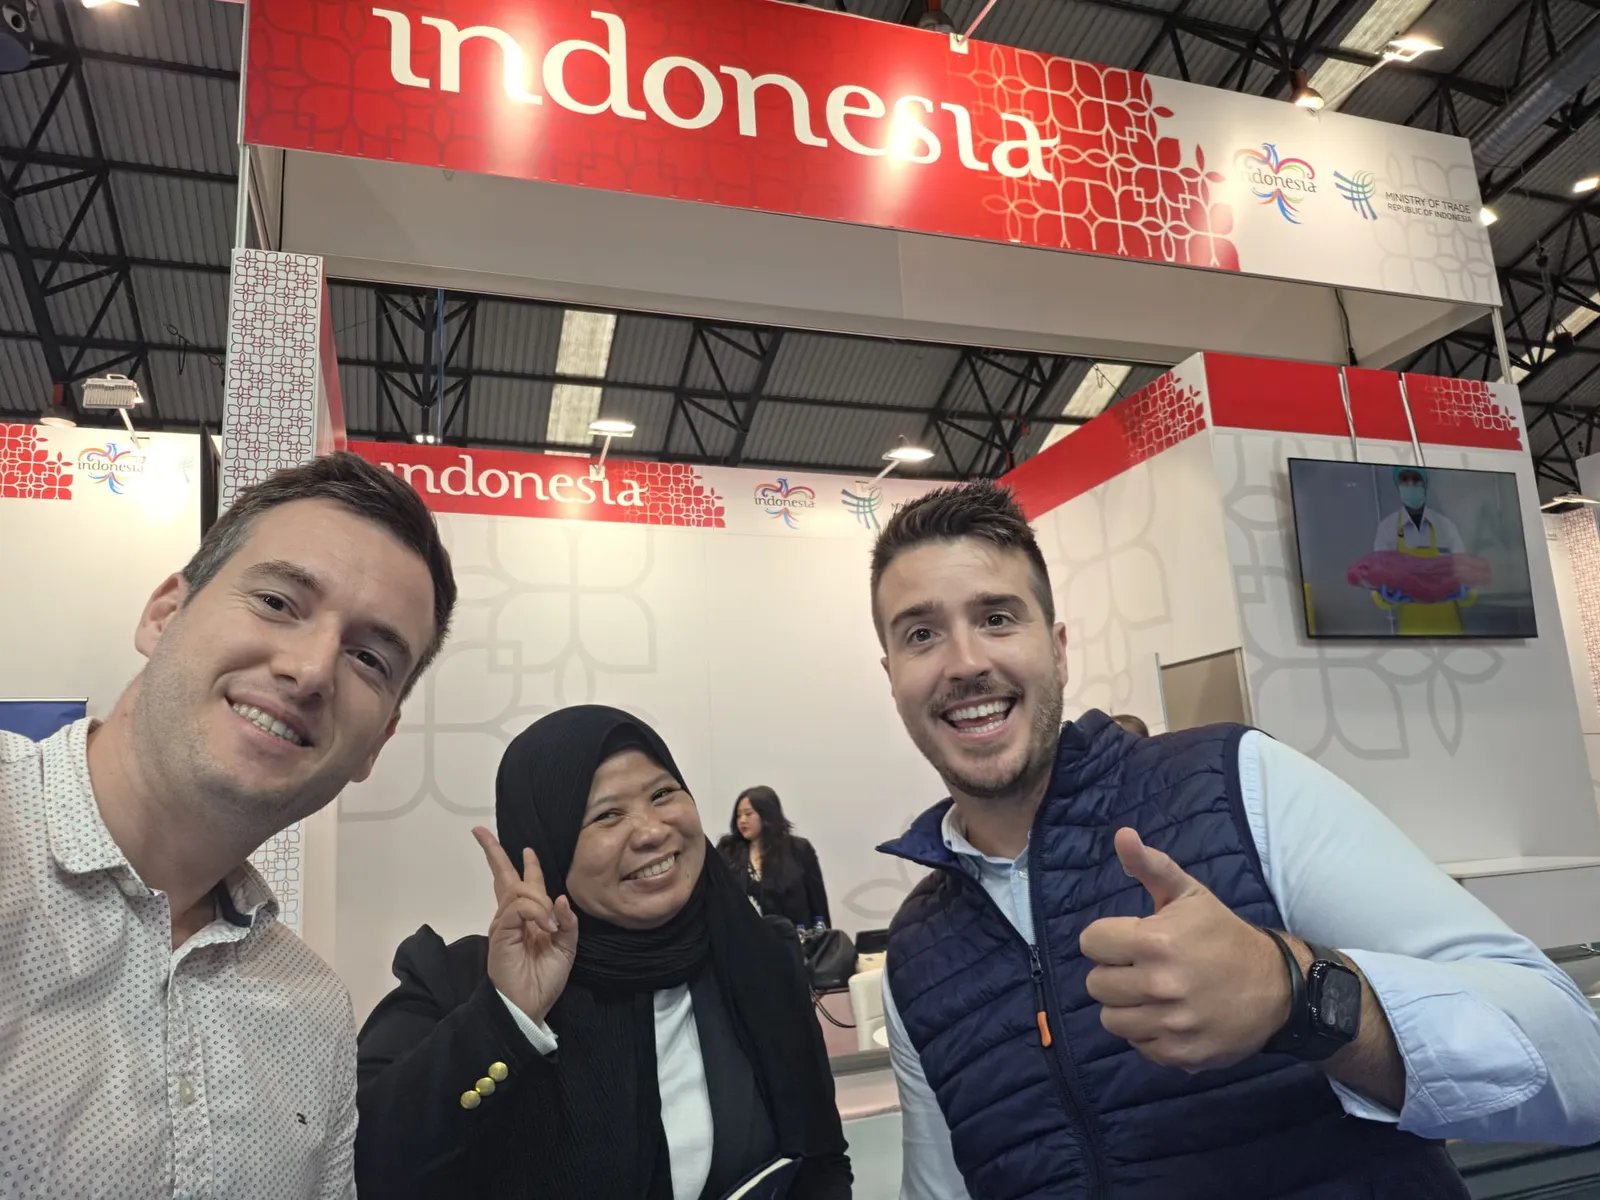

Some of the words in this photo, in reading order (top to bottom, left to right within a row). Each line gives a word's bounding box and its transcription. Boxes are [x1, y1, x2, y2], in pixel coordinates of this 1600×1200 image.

[372, 7, 1060, 182] indonesia
[1385, 191, 1426, 206] MINISTRY
[1427, 198, 1441, 209] OF
[1442, 200, 1472, 214] TRADE
[1387, 202, 1422, 215] REPUBLIC
[1423, 208, 1433, 217] OF
[1434, 211, 1473, 223] INDONESIA
[754, 495, 815, 508] indonesia
